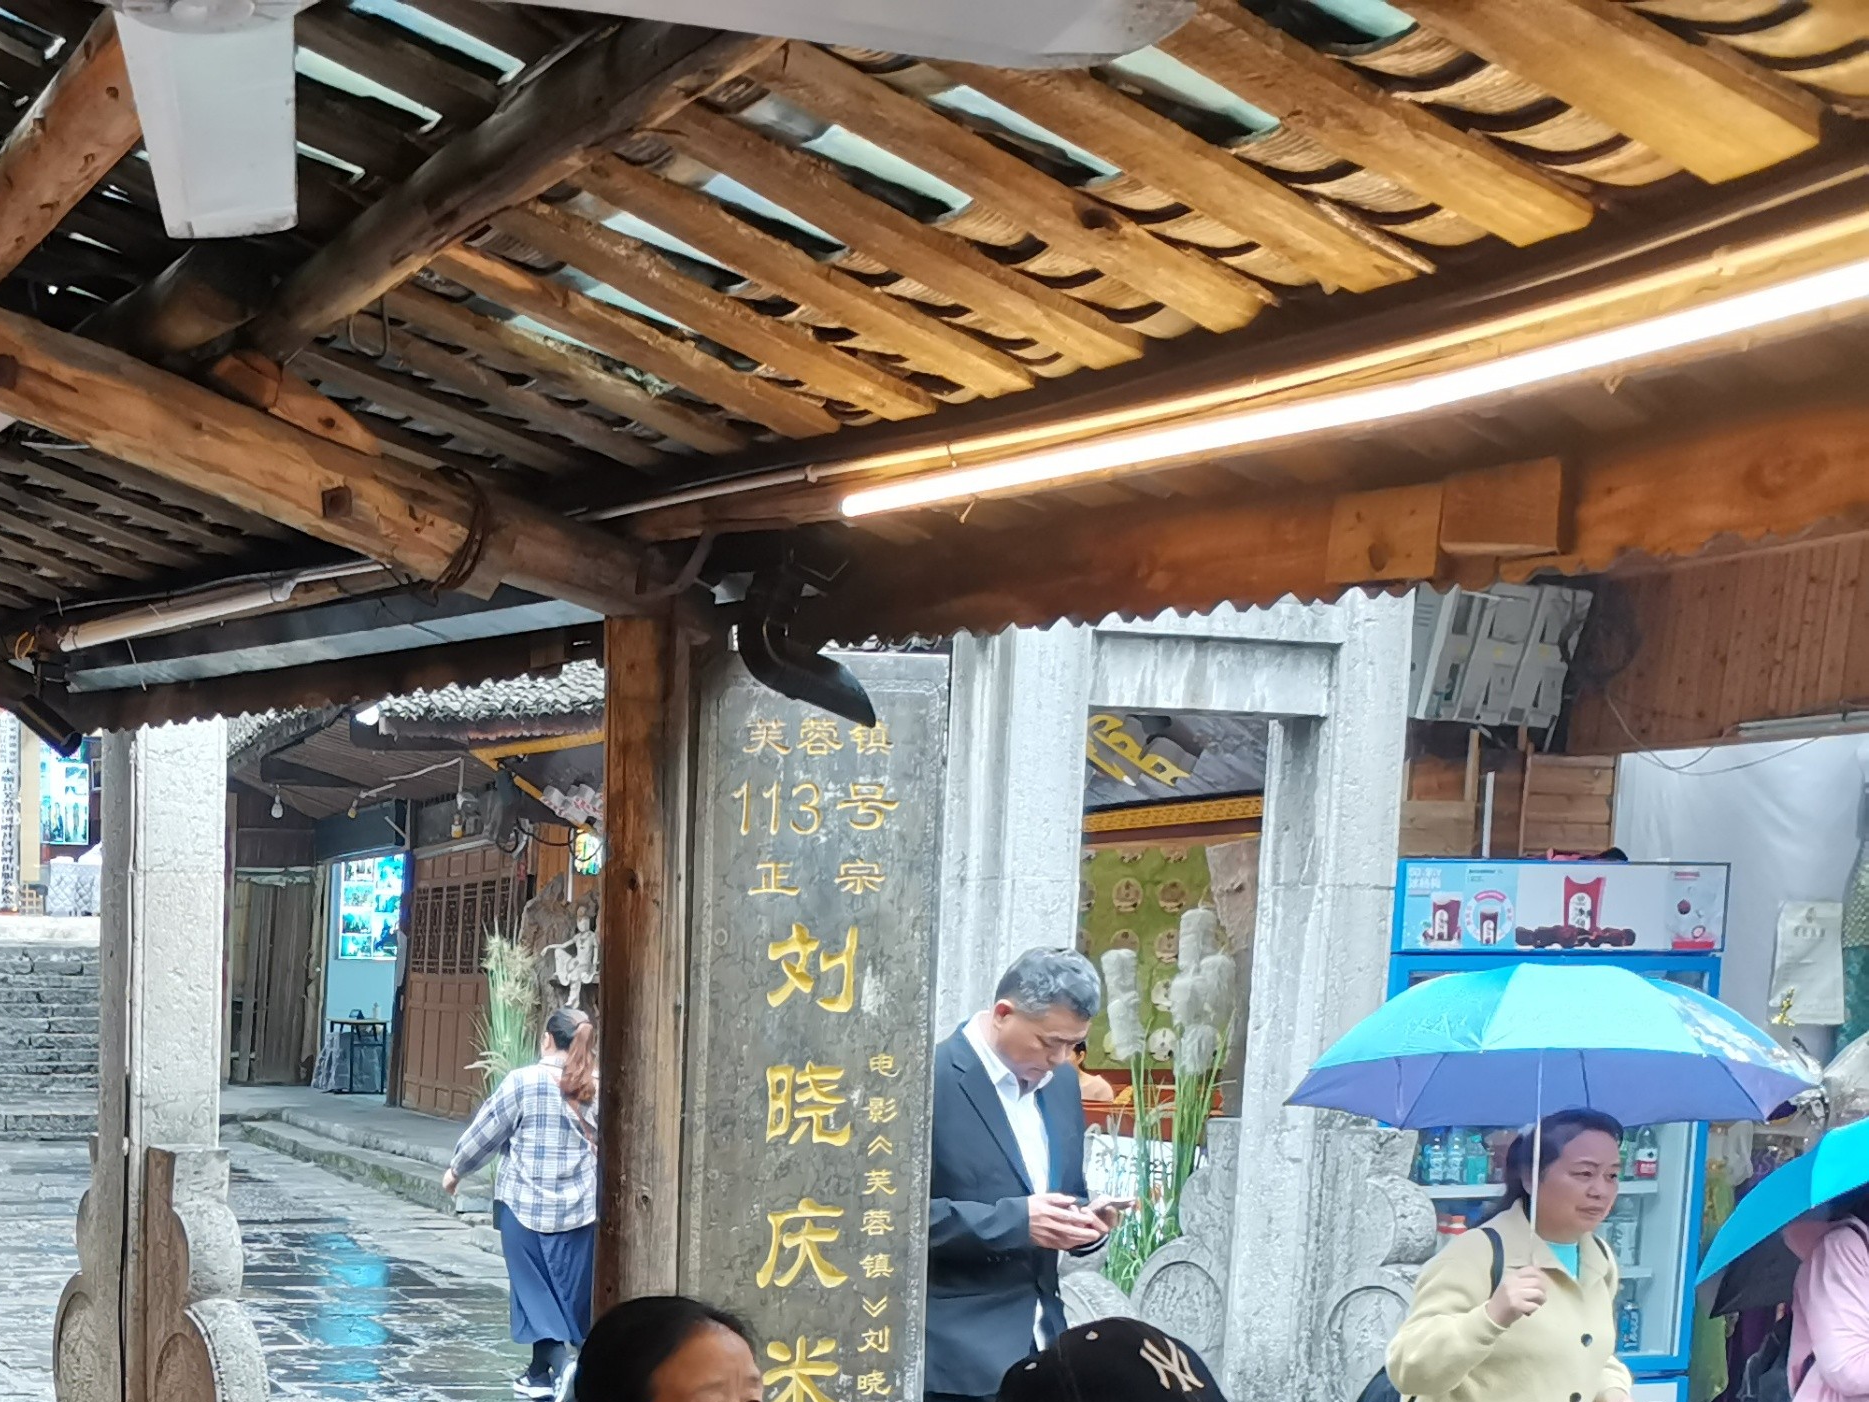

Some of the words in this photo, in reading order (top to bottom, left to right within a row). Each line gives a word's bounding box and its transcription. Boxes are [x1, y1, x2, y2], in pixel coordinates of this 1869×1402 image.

[743, 716, 896, 758] 芙蓉镇
[731, 778, 900, 838] 113号
[747, 858, 887, 898] 正宗
[1139, 1337, 1205, 1392] NY
